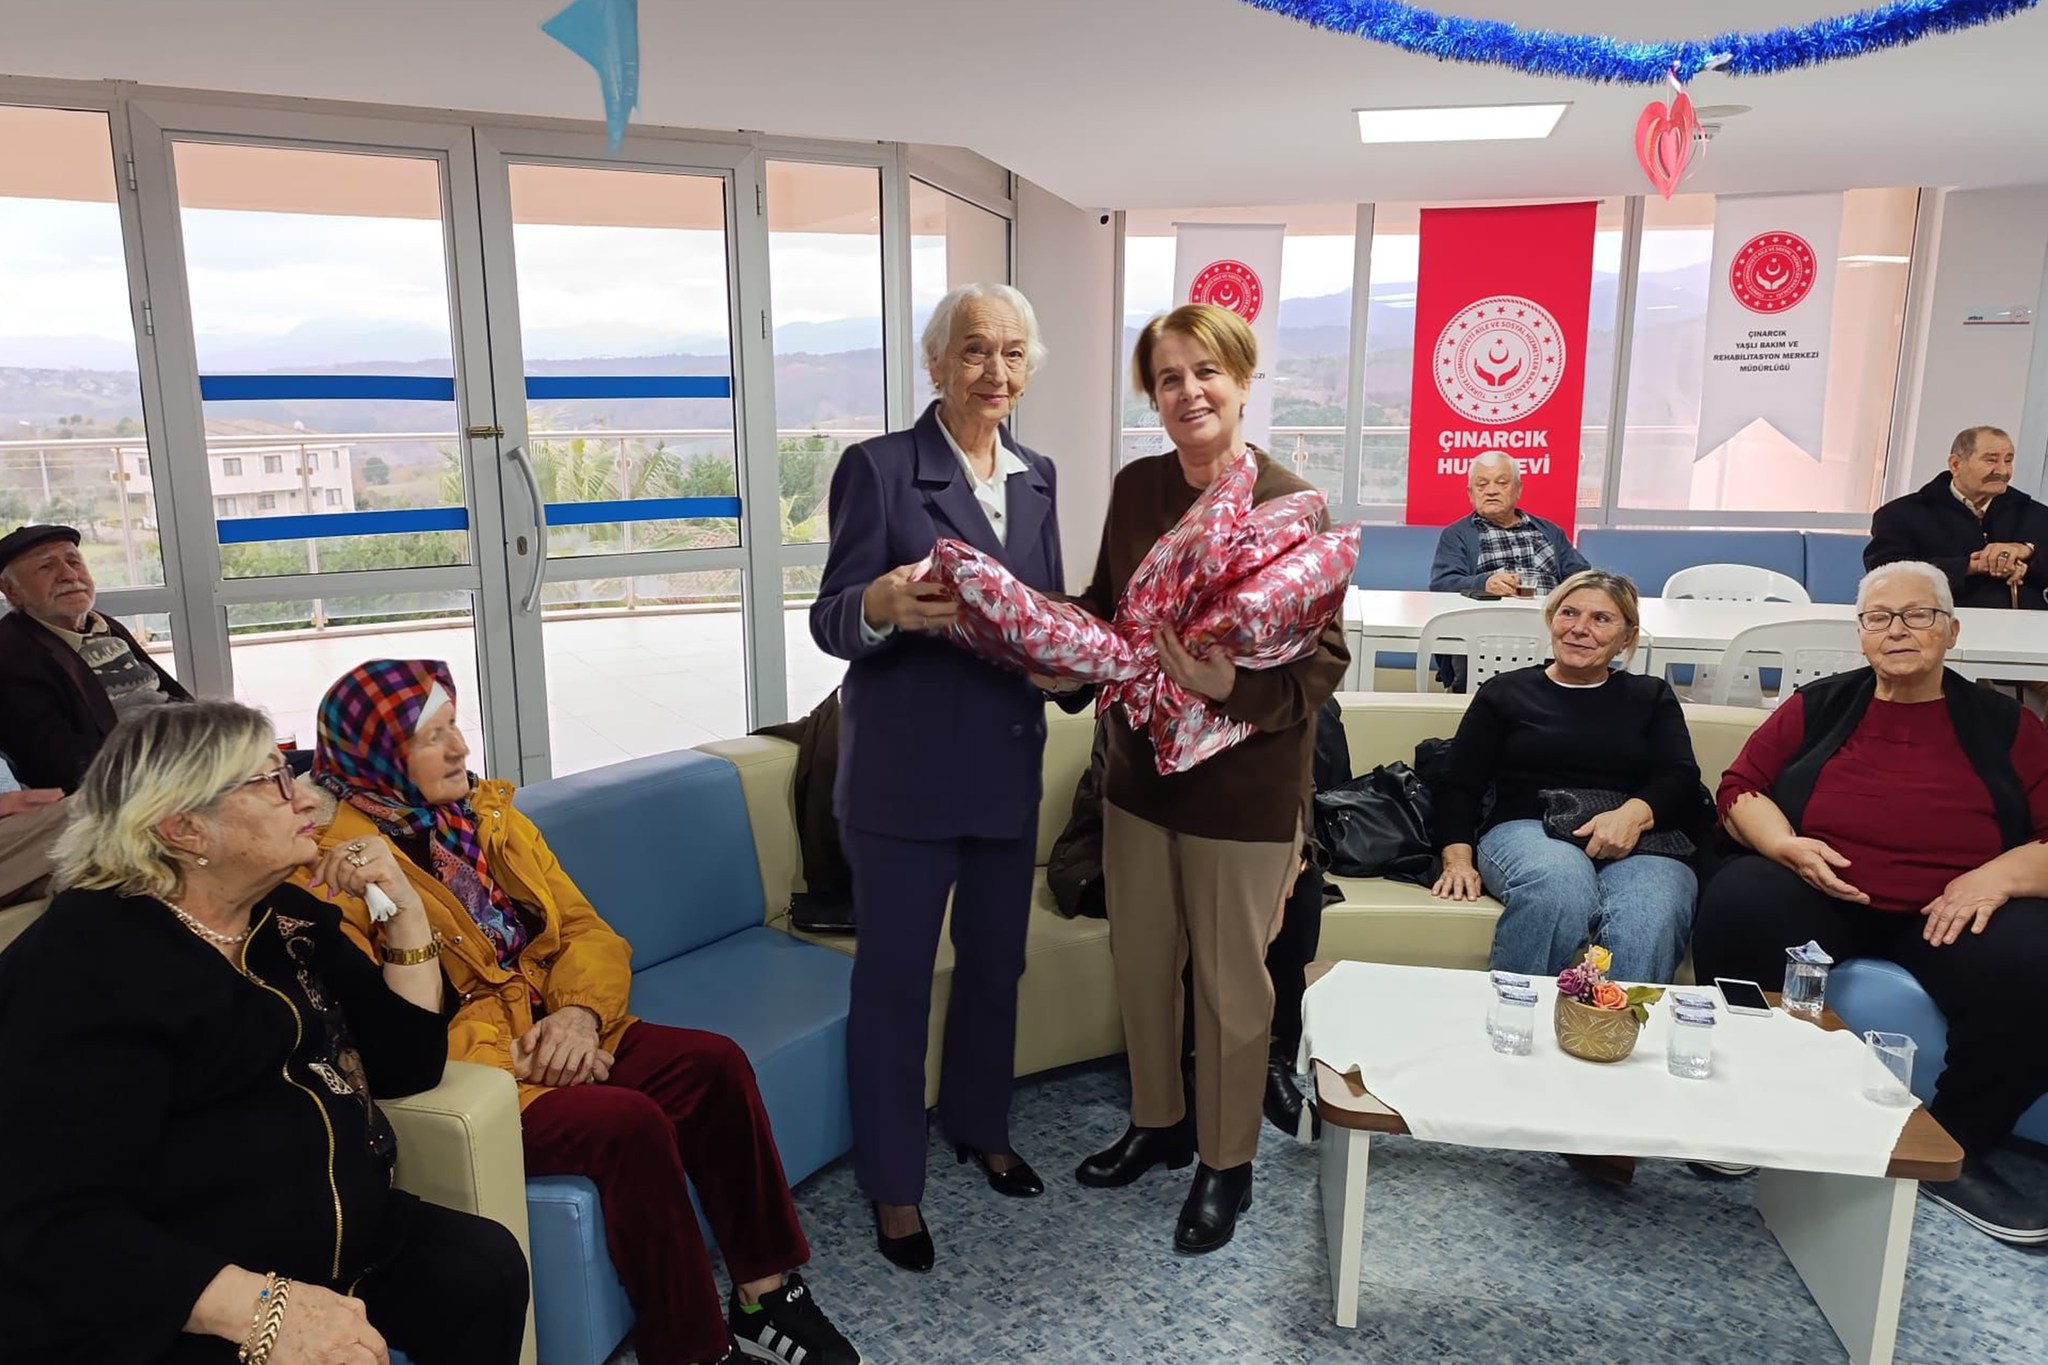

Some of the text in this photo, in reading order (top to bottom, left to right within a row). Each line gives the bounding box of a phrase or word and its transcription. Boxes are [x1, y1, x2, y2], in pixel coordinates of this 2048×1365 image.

[1501, 321, 1525, 335] SOSYAL
[1748, 330, 1787, 338] ÇINARCIK
[1740, 364, 1790, 372] MÜDÜRLÜĞÜ
[1439, 431, 1548, 453] ÇINARCIK
[1437, 454, 1550, 475] HUEVİ
